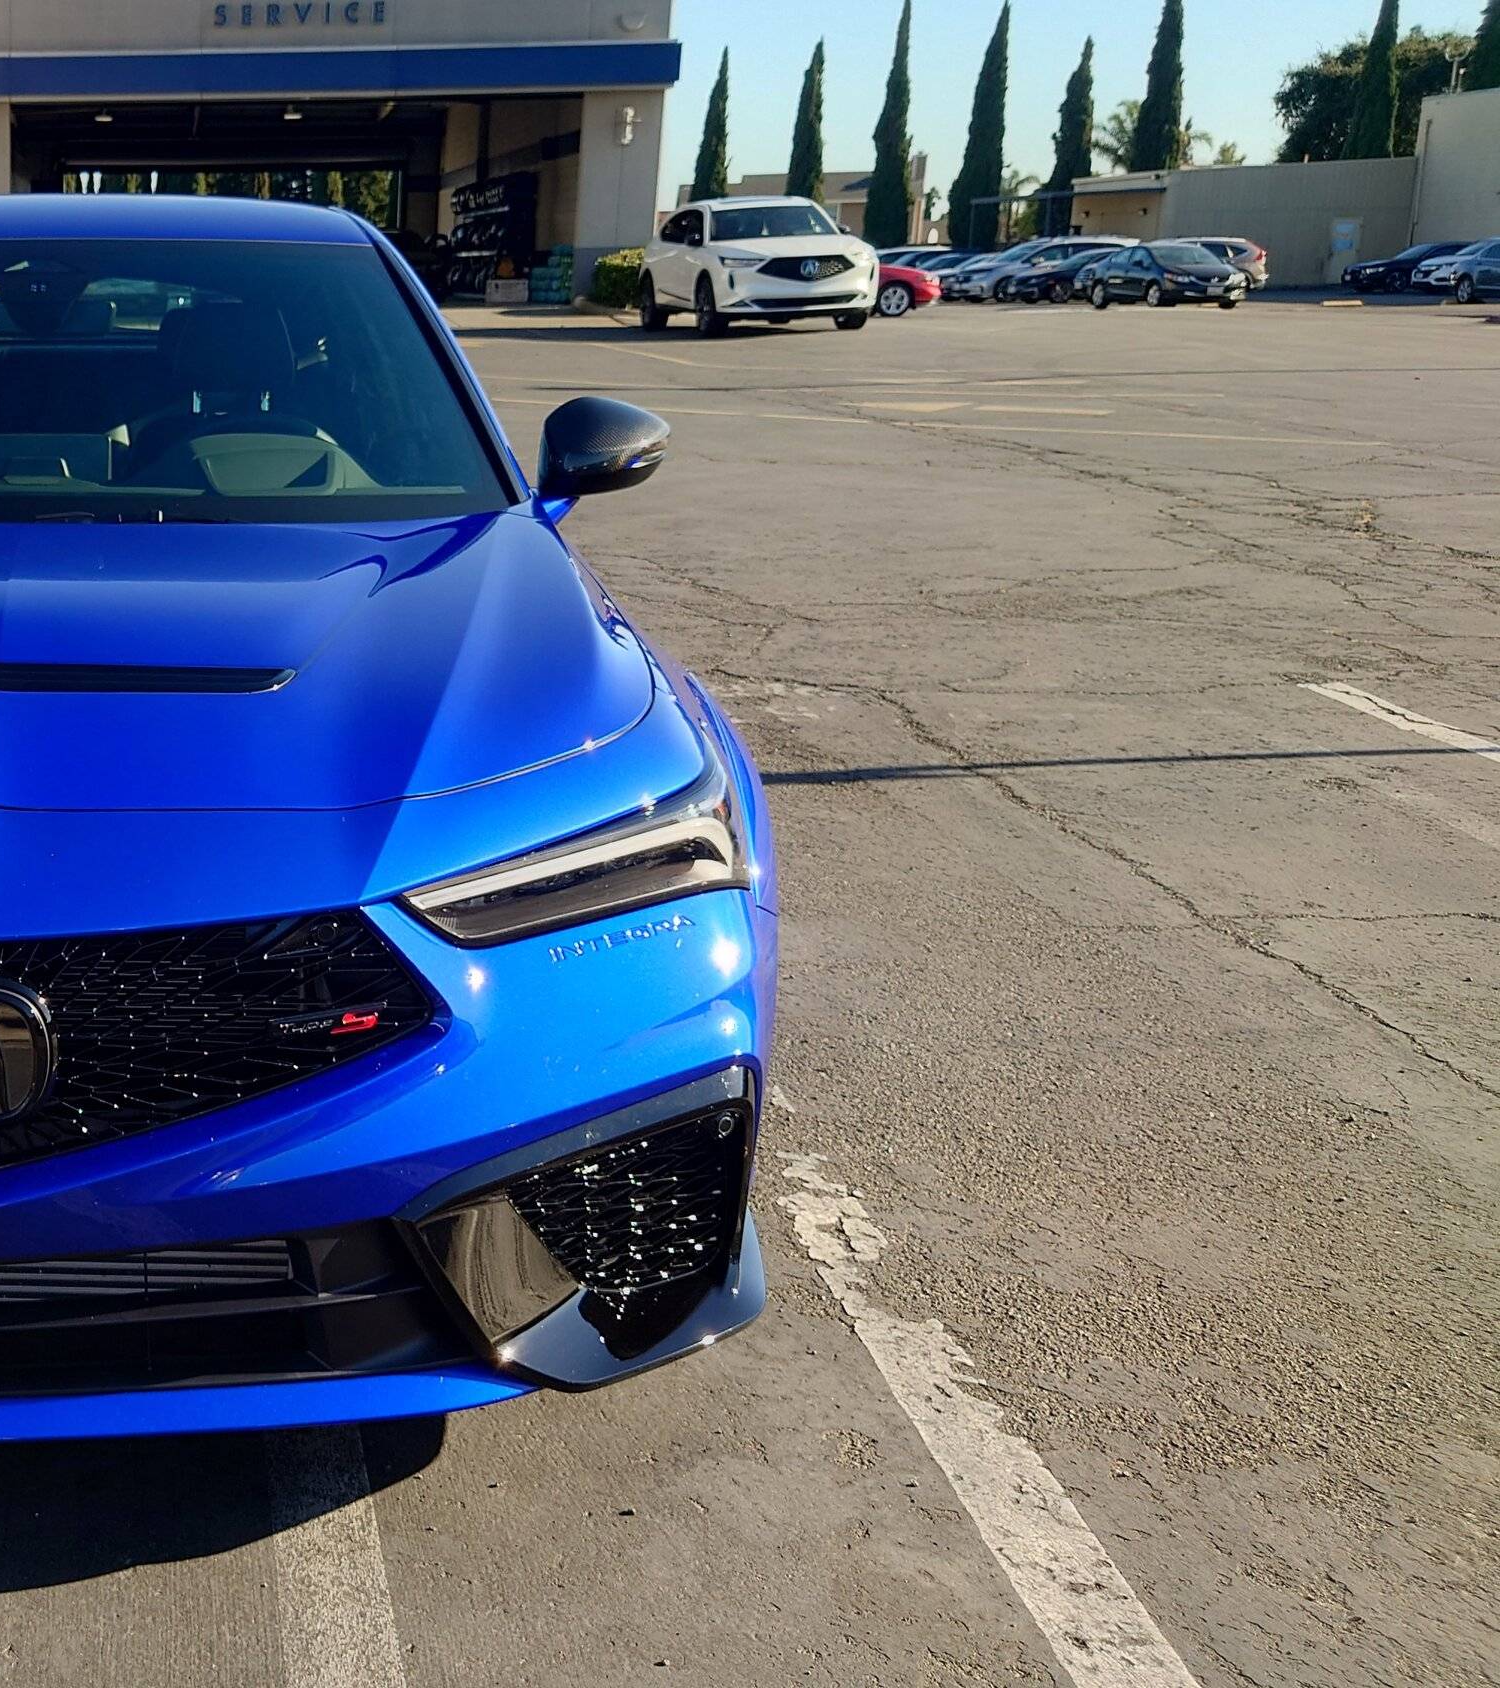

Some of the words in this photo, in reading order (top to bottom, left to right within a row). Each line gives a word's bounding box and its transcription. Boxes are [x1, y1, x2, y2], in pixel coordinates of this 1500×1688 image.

[214, 1, 386, 26] SERVICE
[549, 912, 697, 963] INTEGRA
[329, 1012, 378, 1035] S
